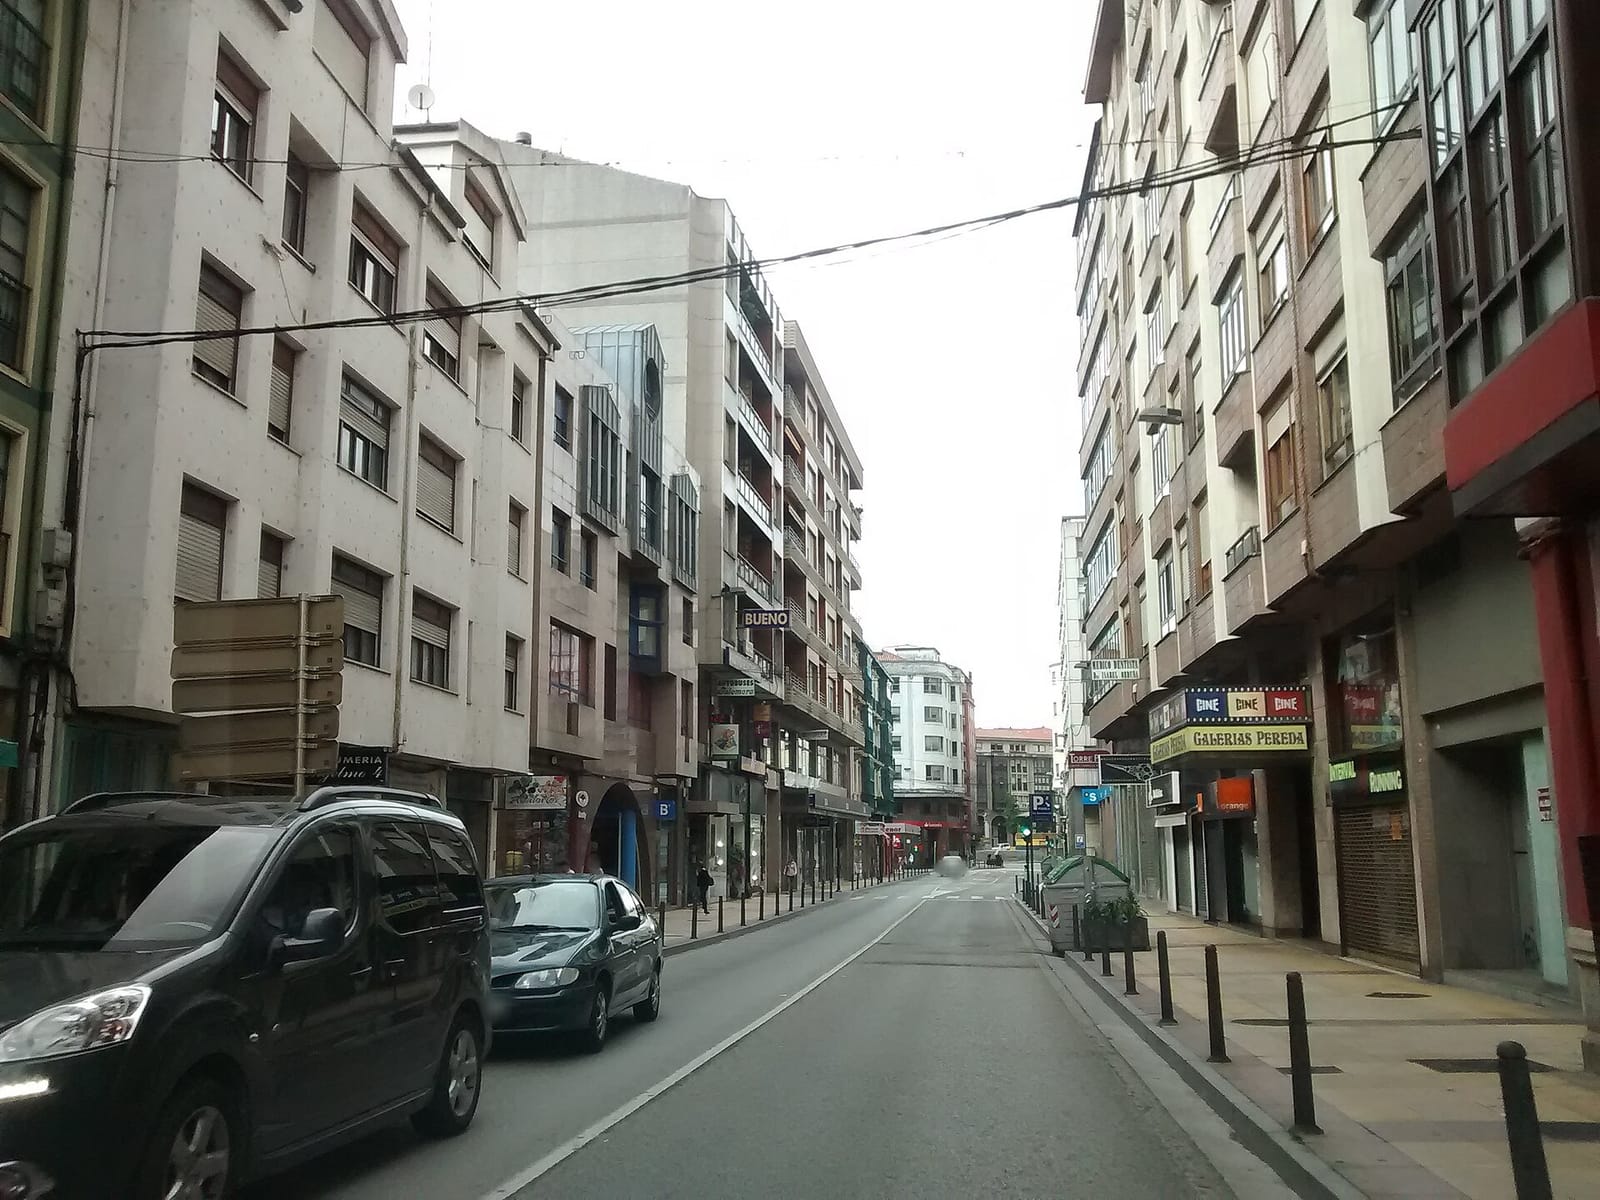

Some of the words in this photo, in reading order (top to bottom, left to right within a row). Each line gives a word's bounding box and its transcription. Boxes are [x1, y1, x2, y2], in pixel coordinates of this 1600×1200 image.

[745, 612, 788, 625] BUENO
[1196, 698, 1220, 712] CINE
[1235, 698, 1258, 711] CINE
[1274, 697, 1298, 711] CINE
[1194, 731, 1253, 746] GALERIAS
[1257, 730, 1305, 746] PEREDA
[1369, 770, 1402, 793] RUNNING
[1032, 795, 1044, 811] P
[1220, 803, 1249, 811] orange
